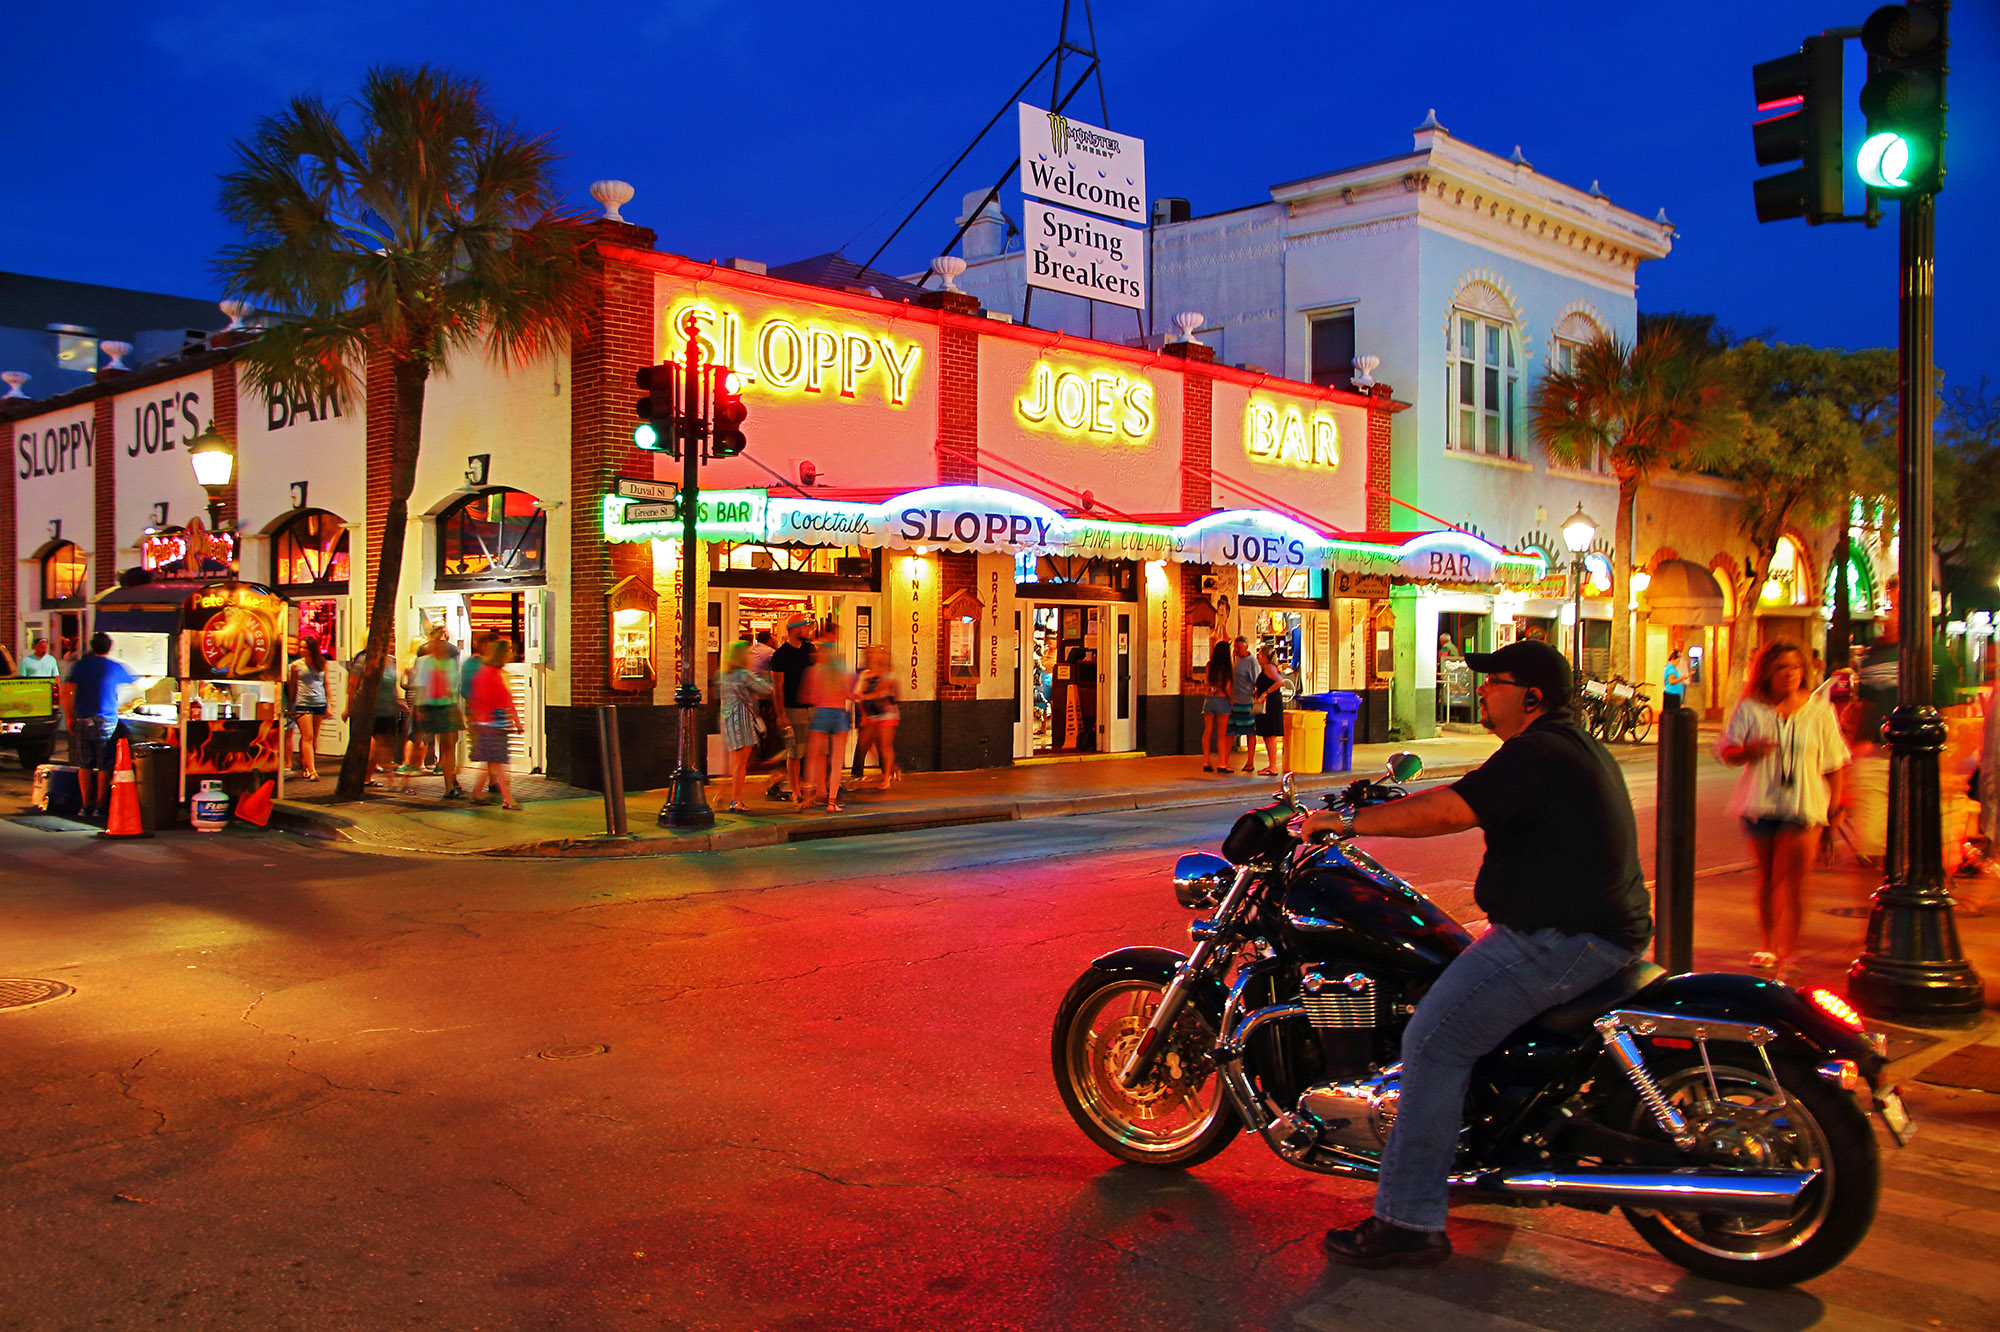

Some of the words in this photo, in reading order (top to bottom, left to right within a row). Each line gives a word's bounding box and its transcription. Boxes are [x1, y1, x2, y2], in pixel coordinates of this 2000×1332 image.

[1066, 127, 1121, 154] MONSTER
[1076, 143, 1114, 158] ENERGY
[1028, 160, 1140, 213] Welcome
[1042, 211, 1123, 262] Spring
[1033, 249, 1140, 298] Breakers
[675, 305, 921, 405] SLOPPY
[1018, 364, 1153, 438] JOE'S
[128, 391, 200, 457] JOE'S
[1249, 404, 1339, 467] BAR
[19, 418, 96, 480] SLOPPY
[630, 483, 655, 496] Duval
[657, 486, 666, 497] St
[634, 507, 659, 517] Greene
[661, 506, 668, 516] St
[716, 501, 751, 523] BAR
[791, 510, 872, 535] Cocktails
[901, 508, 1052, 547] SLOPPY
[1082, 527, 1111, 549] PINA
[1223, 534, 1305, 565] JOE'S
[1429, 551, 1472, 577] BAR
[991, 571, 999, 627] DRAFT
[246, 617, 266, 652] West
[910, 611, 919, 690] COLADAS
[990, 635, 998, 678] BEER
